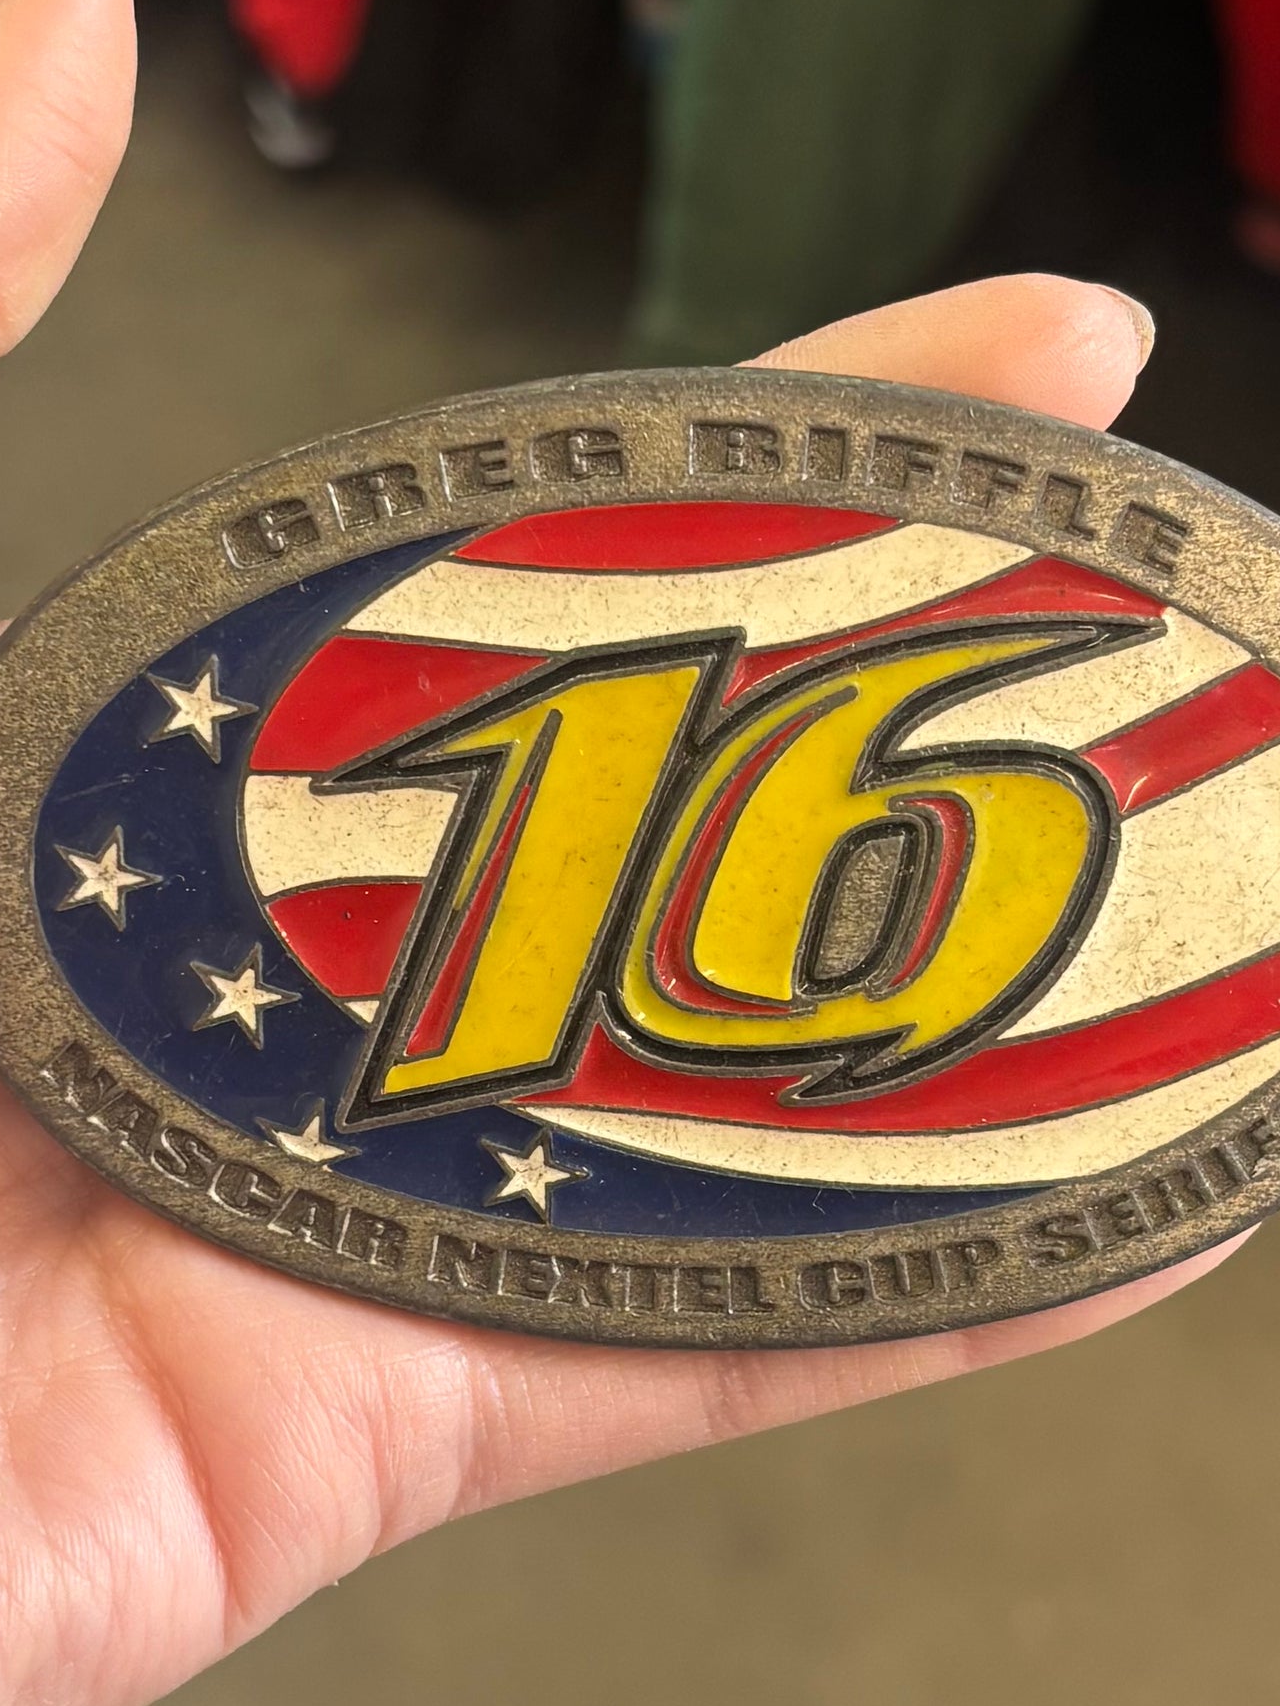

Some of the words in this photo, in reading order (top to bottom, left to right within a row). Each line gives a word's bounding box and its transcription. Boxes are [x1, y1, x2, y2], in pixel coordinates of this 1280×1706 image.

[220, 426, 625, 571] GREG
[688, 420, 1189, 575] BIFFLE
[309, 614, 1170, 1131] 16
[39, 1038, 408, 1272] NASCAR
[426, 1233, 776, 1315] NEXTEL
[796, 1238, 1002, 1314] CUP
